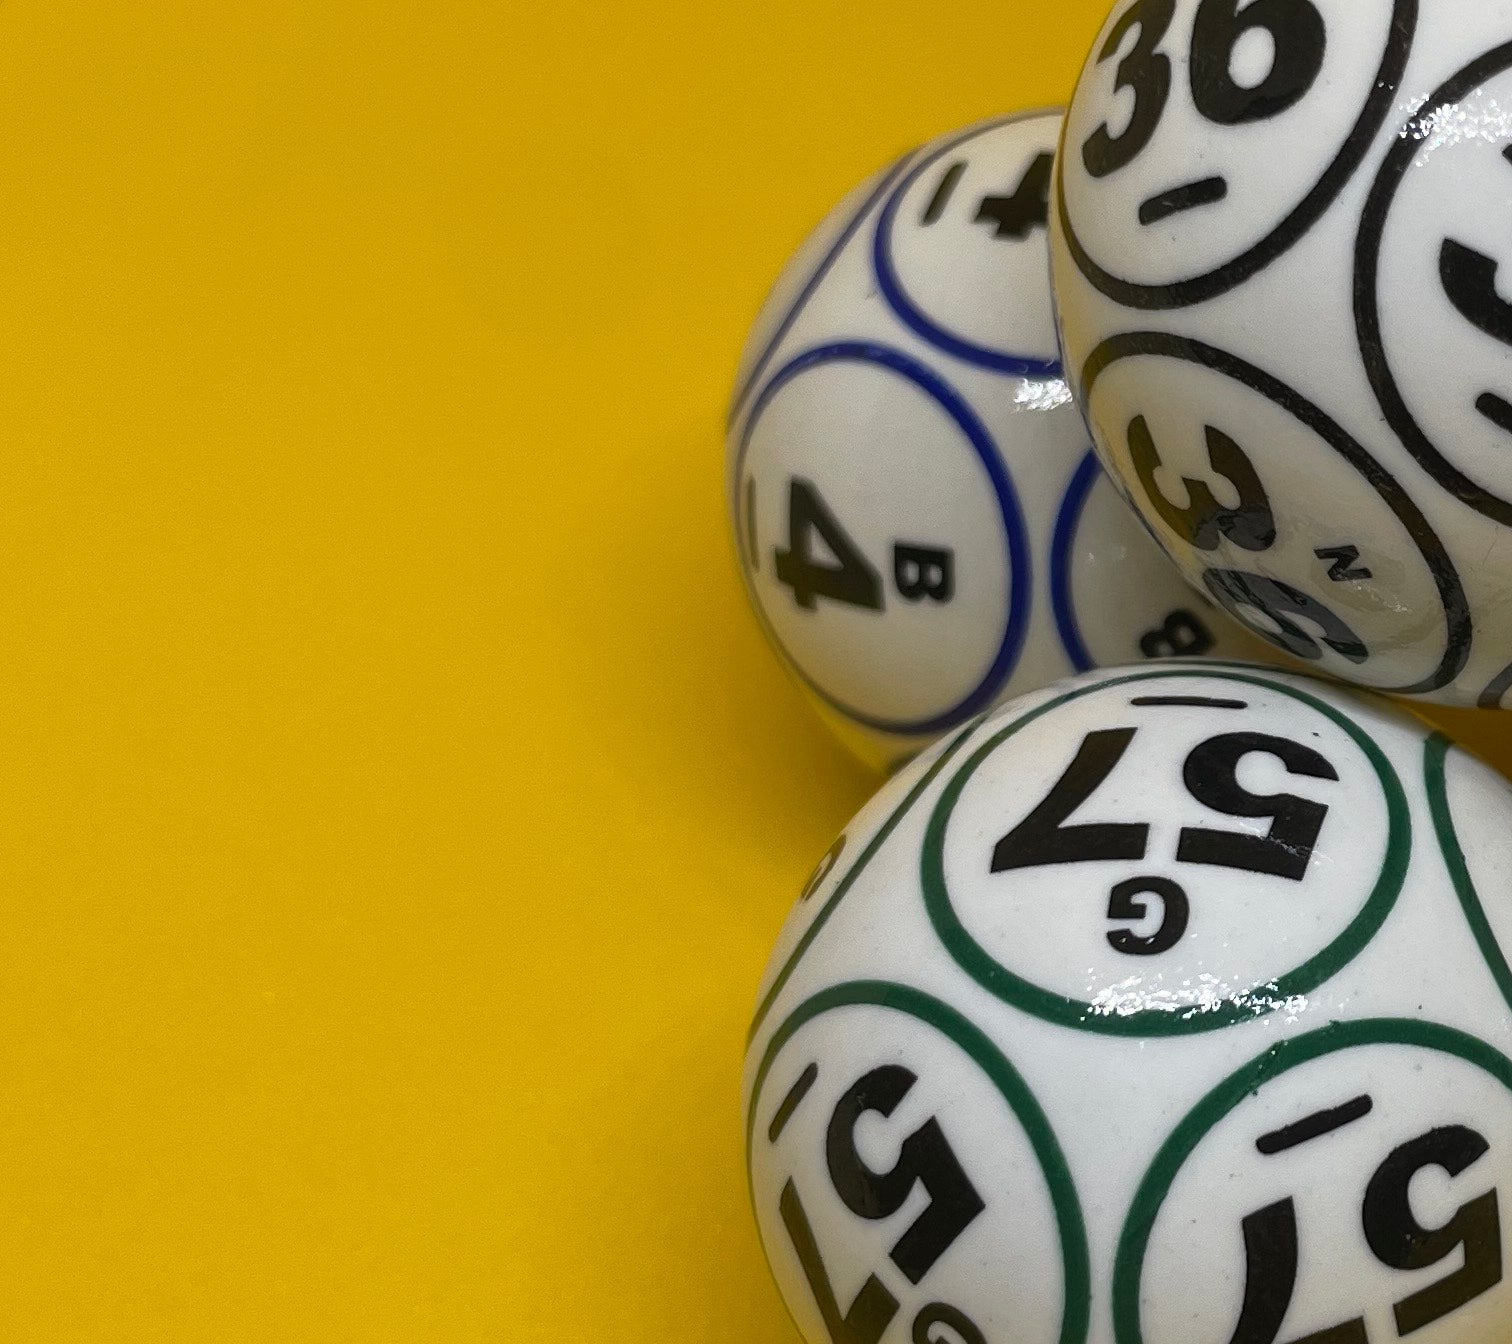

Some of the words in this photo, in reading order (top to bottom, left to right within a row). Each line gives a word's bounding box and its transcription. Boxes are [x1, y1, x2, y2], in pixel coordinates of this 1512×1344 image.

[775, 479, 885, 614] 4
[893, 540, 955, 624] B
[1126, 413, 1370, 665] 36
[1313, 545, 1373, 582] N
[990, 726, 1340, 882] 57
[1106, 876, 1190, 955] G
